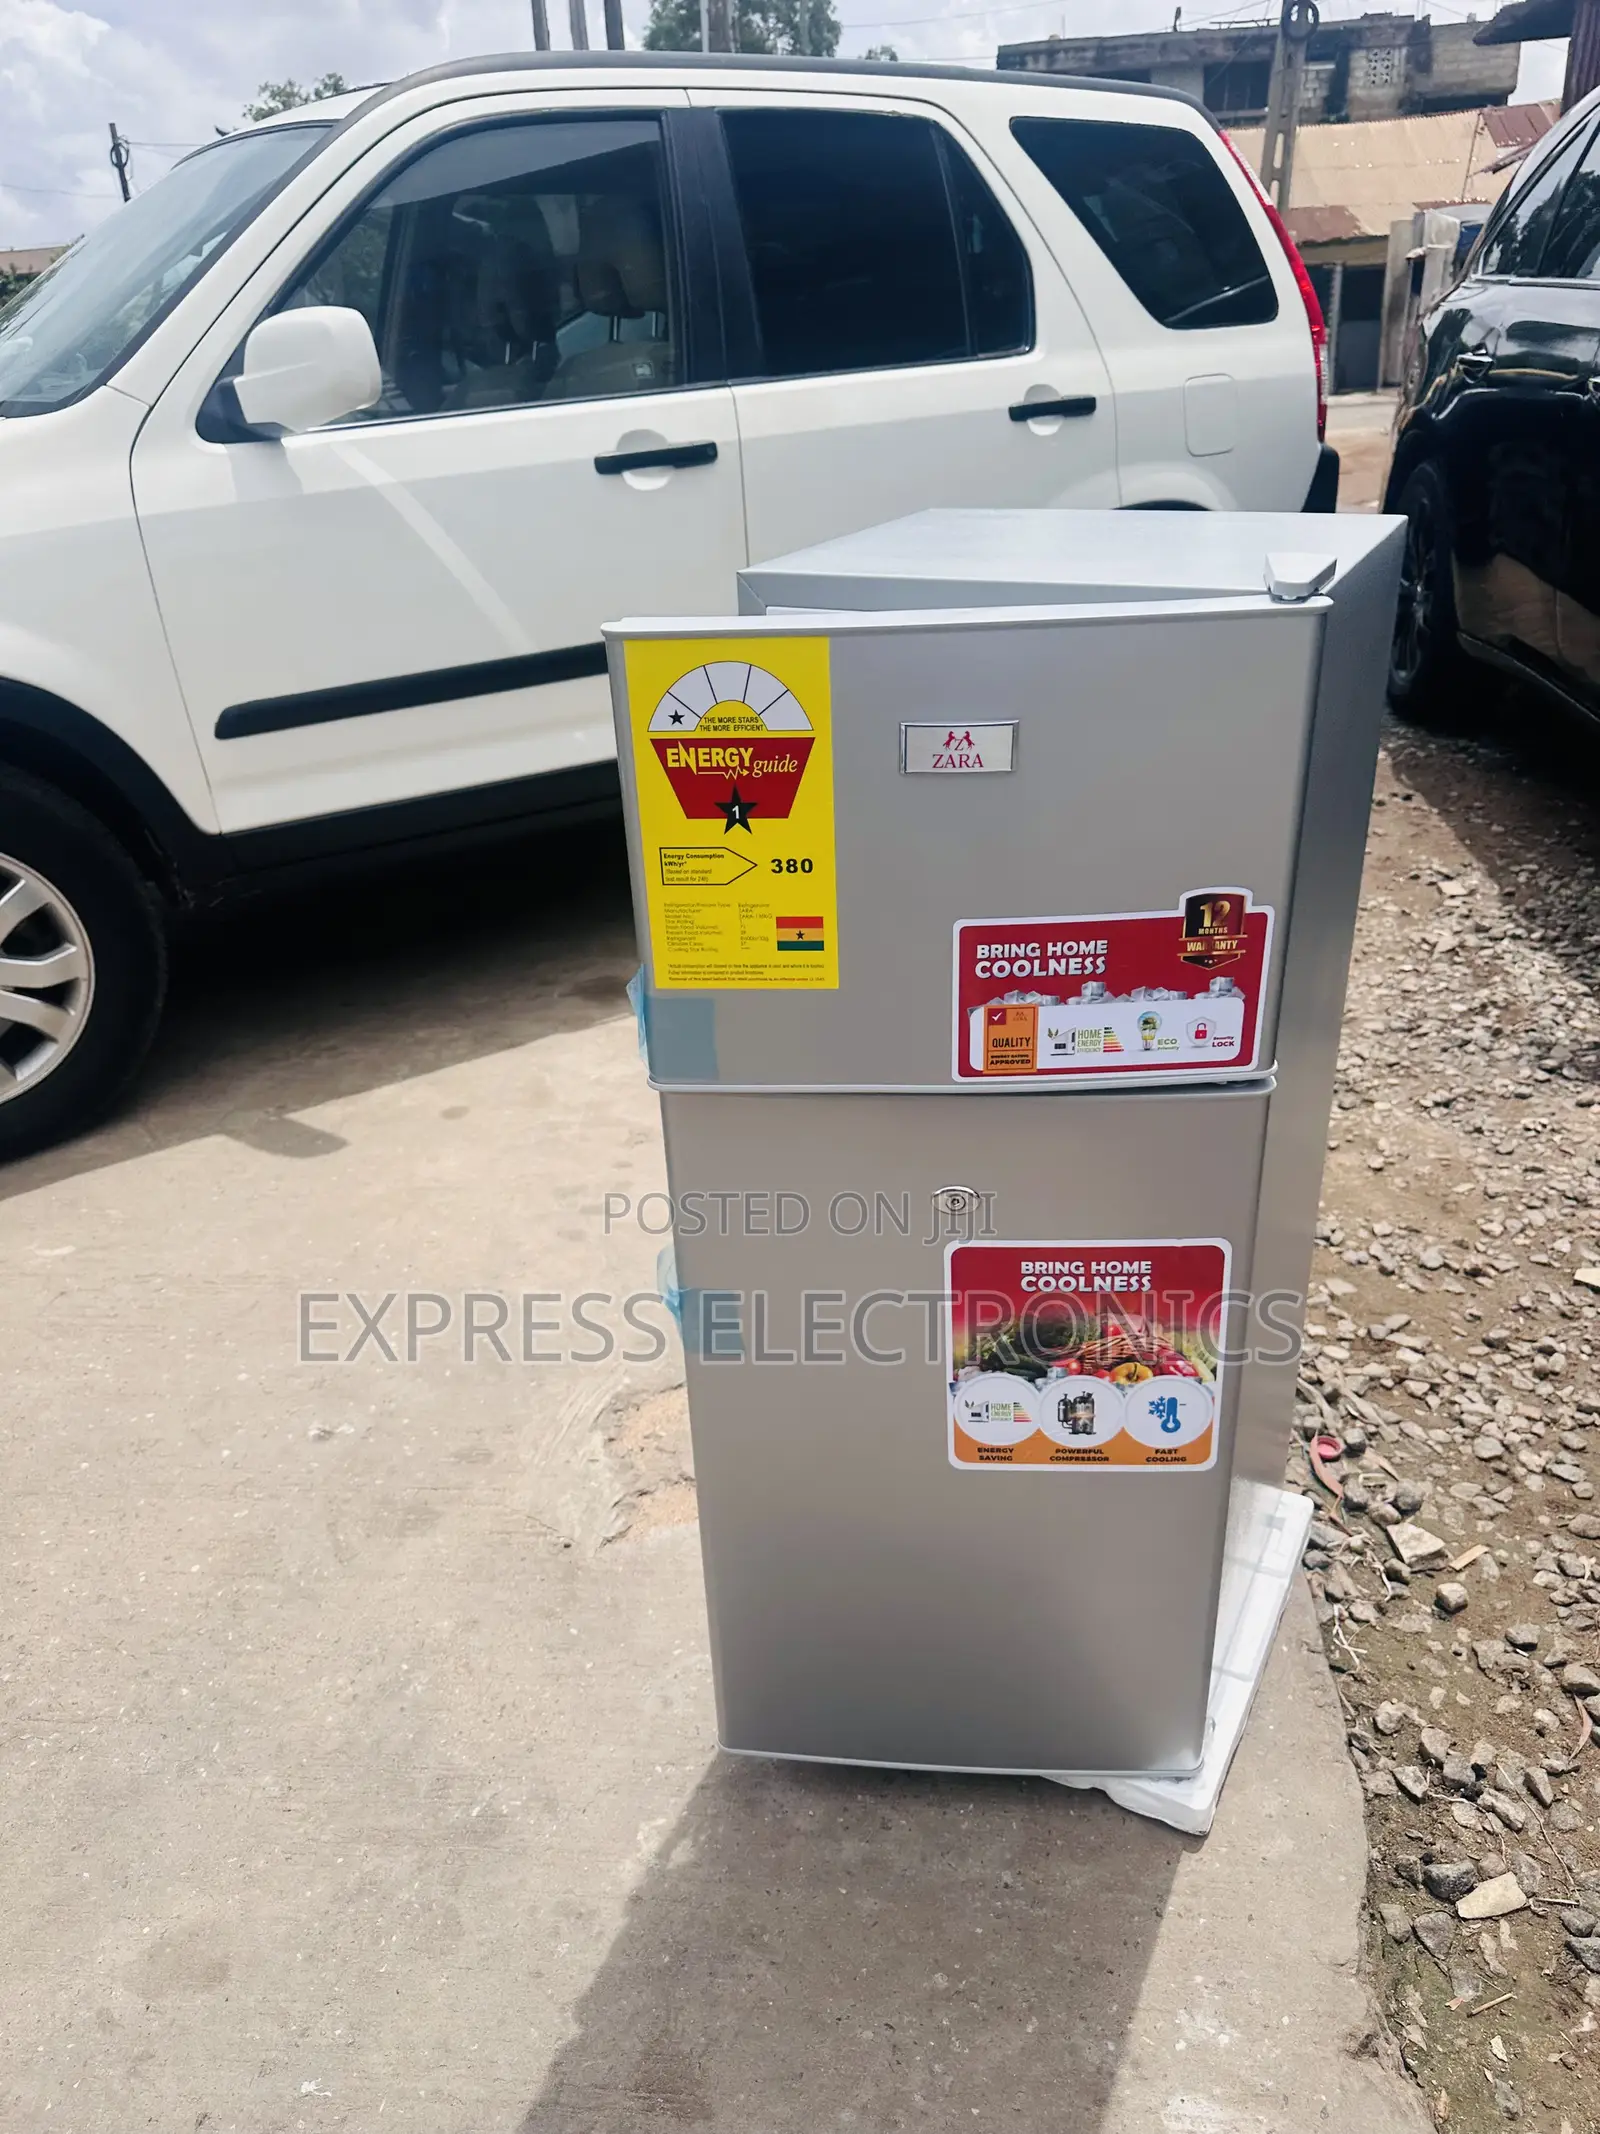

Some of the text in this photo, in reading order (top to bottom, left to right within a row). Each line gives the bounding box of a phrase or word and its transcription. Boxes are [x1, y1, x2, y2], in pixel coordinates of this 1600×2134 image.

[704, 716, 759, 724] THE MORE STARS
[733, 724, 764, 732] EFFICIENT
[666, 741, 798, 779] ENERGY guide
[932, 752, 985, 769] ZARA
[731, 805, 740, 819] 1
[770, 858, 813, 874] 380
[1199, 900, 1231, 928] 12
[1198, 926, 1228, 935] MONTHS
[976, 939, 1108, 959] BRING HOME
[1186, 939, 1238, 952] WAANTY
[974, 955, 1107, 979] COOLNESS
[1077, 1028, 1103, 1040] HOME
[992, 1036, 1031, 1048] QUALITY
[1077, 1039, 1102, 1048] ENERGY
[1157, 1038, 1178, 1046] ECO
[989, 1058, 1031, 1066] APPROVED
[1020, 1260, 1152, 1275] BRING HOME
[1020, 1275, 1153, 1293] COOLNESS
[977, 1447, 1014, 1455] ENERGY
[978, 1454, 1013, 1462] SAVING
[1049, 1455, 1110, 1463] COMPRESSOR
[1145, 1455, 1187, 1463] COOLING
